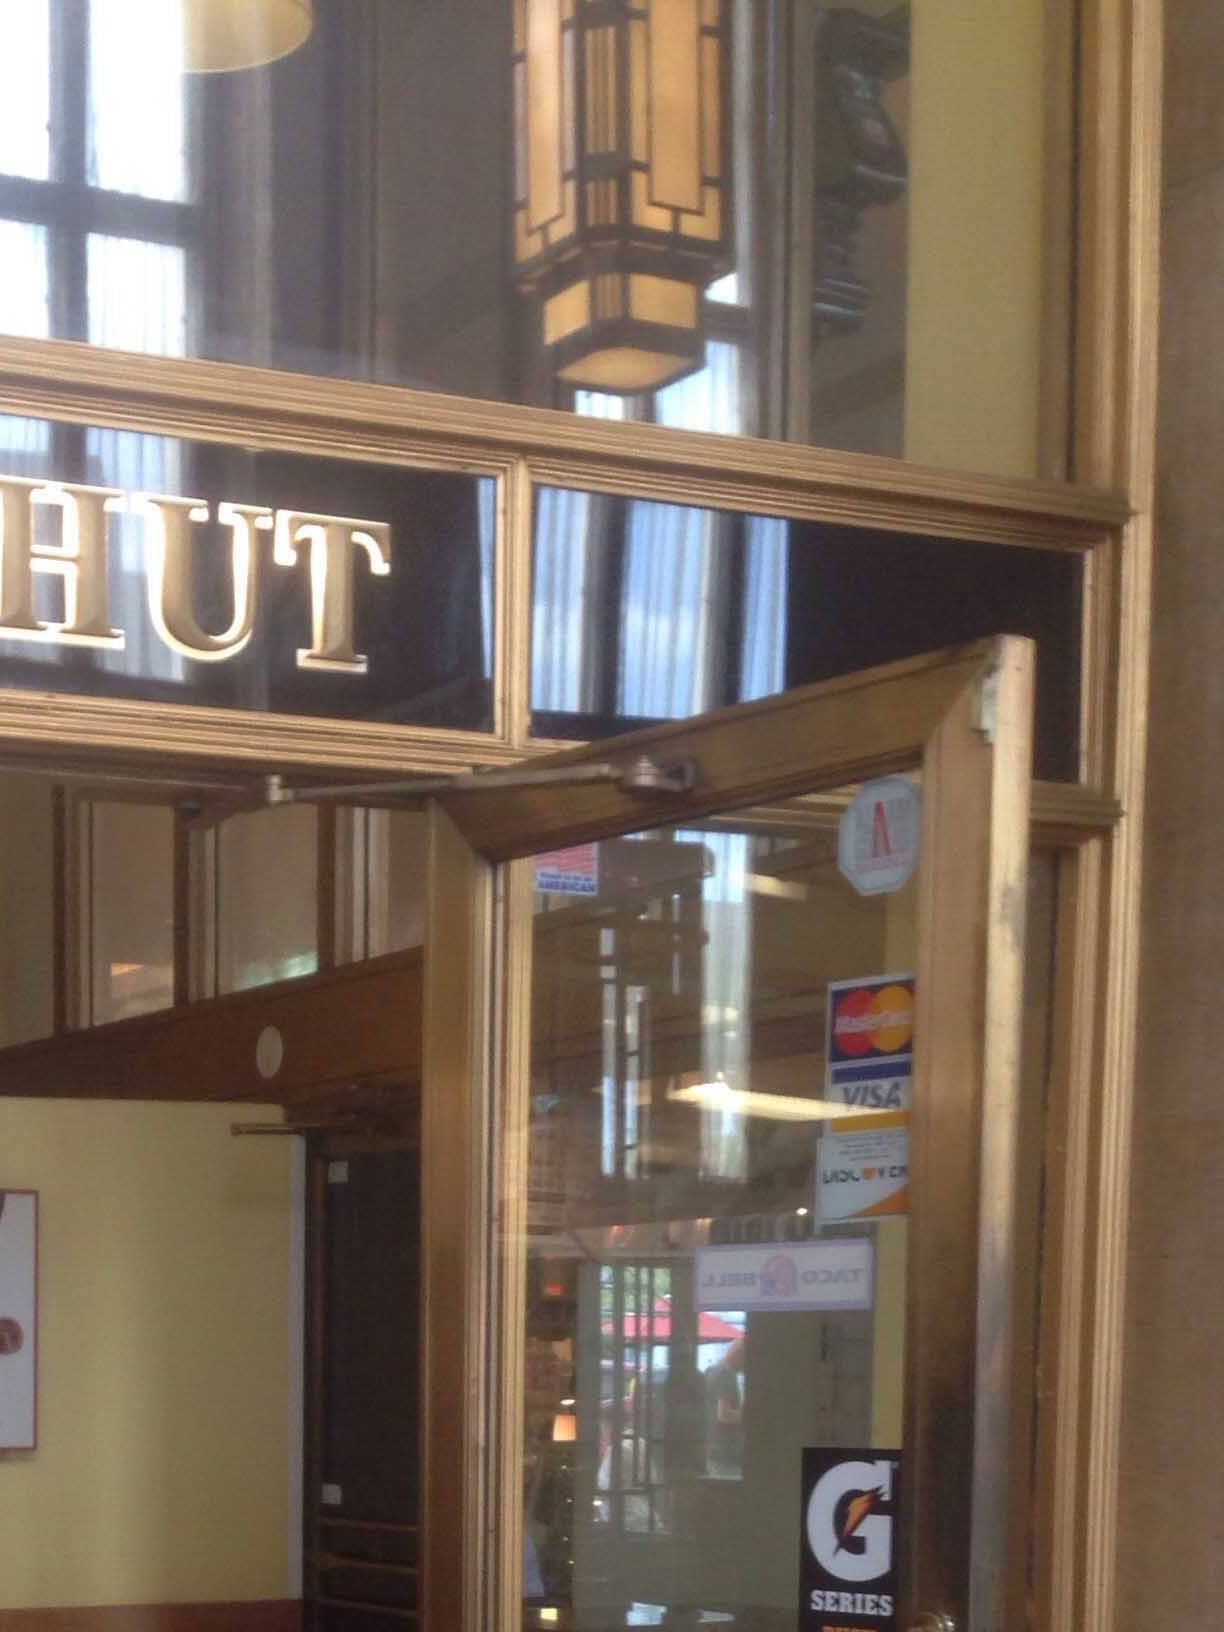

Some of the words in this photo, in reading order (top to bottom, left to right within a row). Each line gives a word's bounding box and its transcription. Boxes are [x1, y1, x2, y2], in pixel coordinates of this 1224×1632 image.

[841, 1083, 902, 1108] VISA
[807, 1460, 894, 1583] G
[810, 1588, 894, 1617] SERIES
